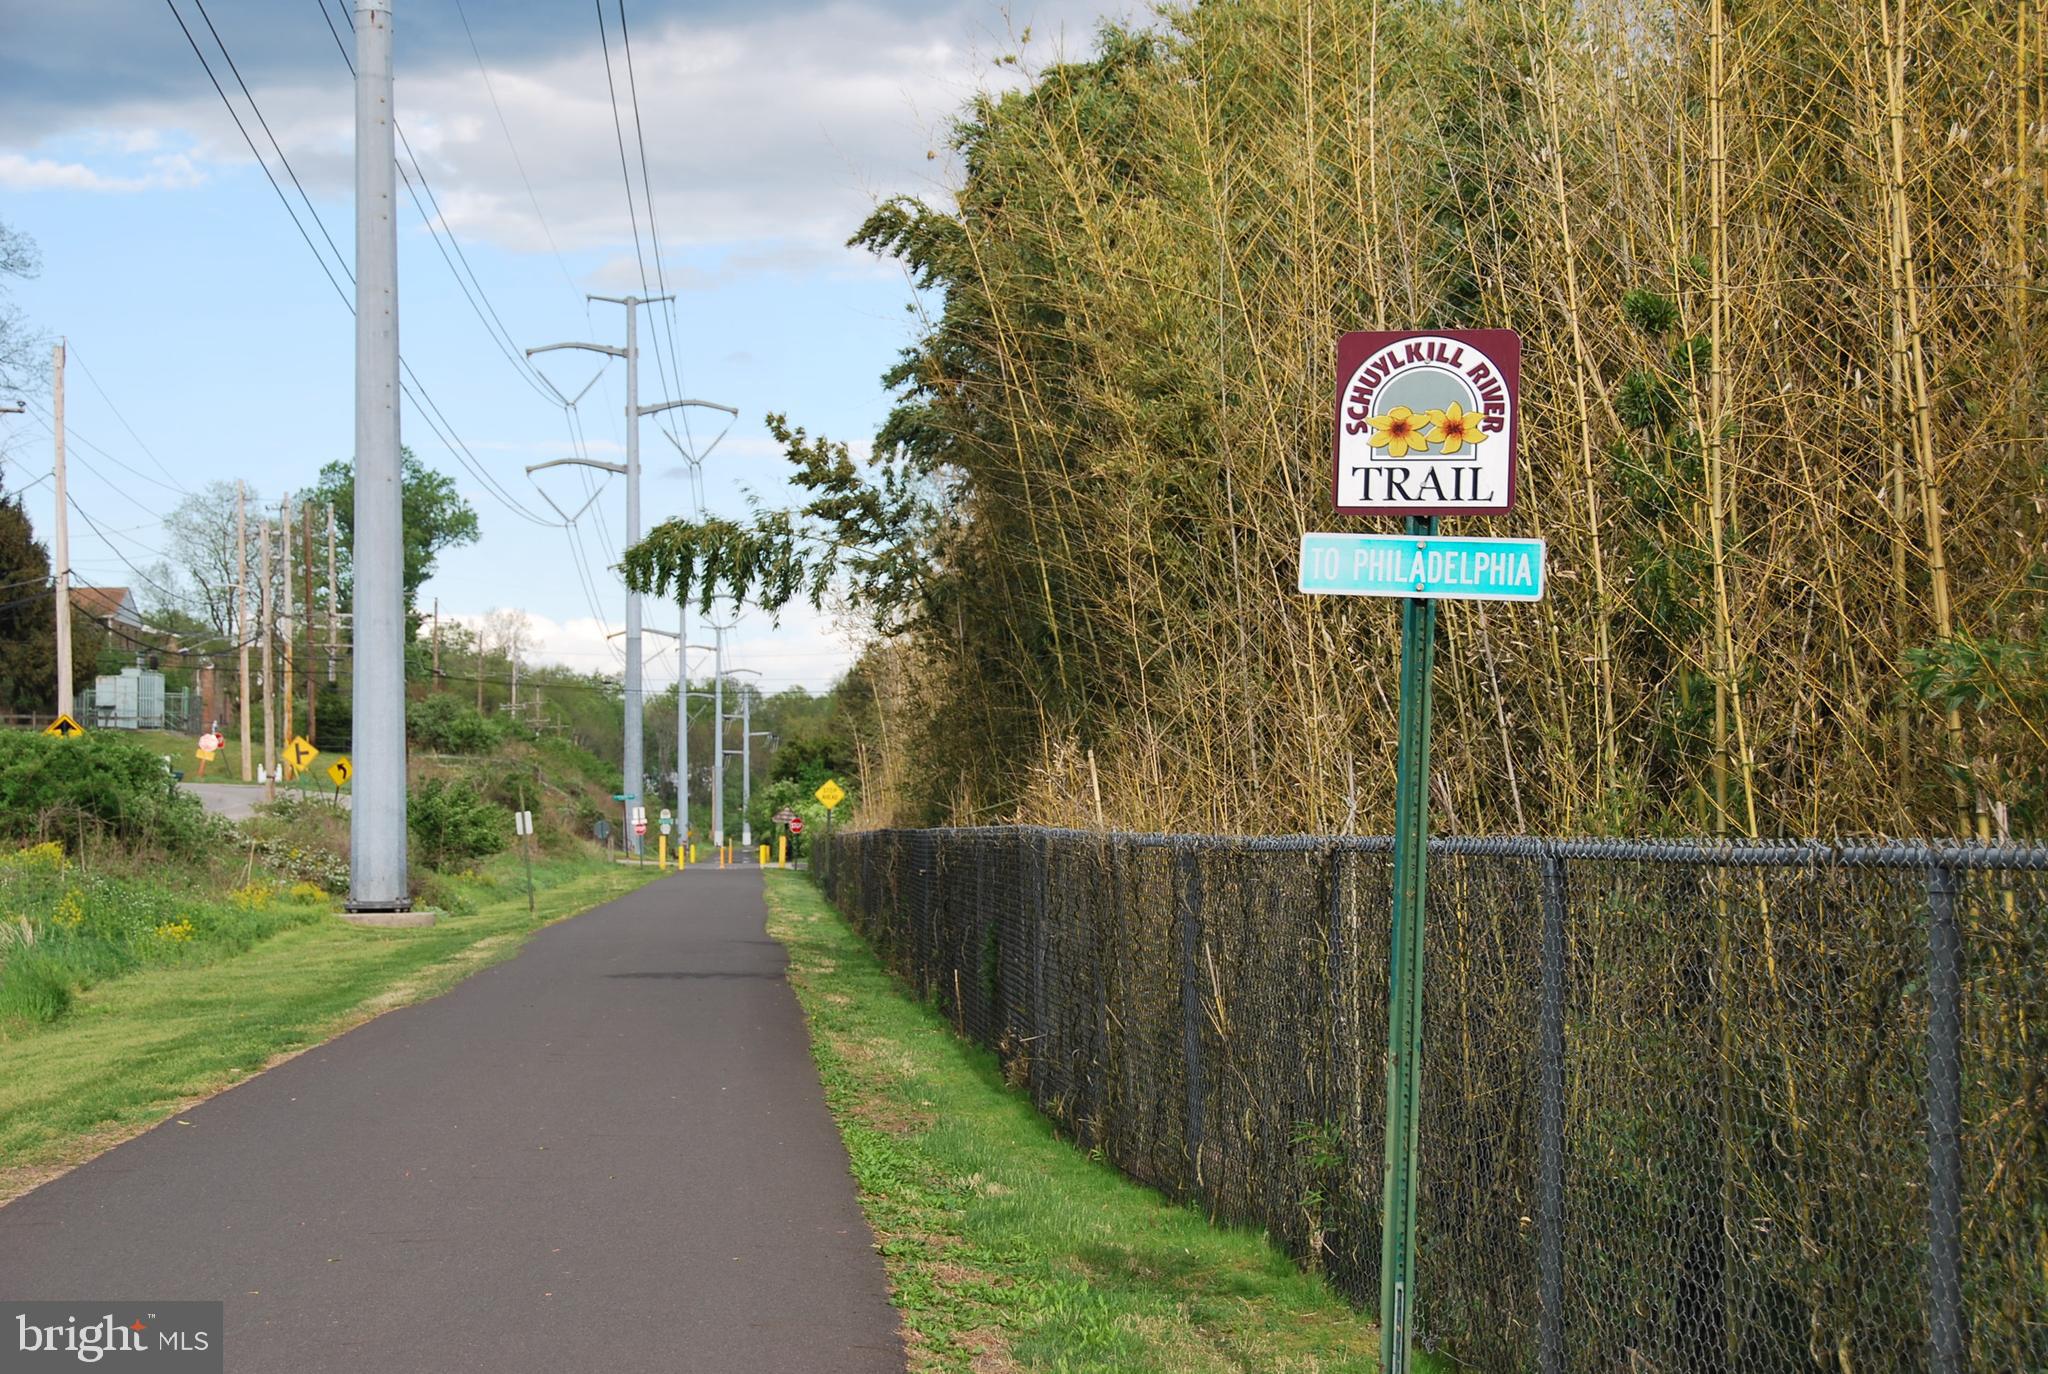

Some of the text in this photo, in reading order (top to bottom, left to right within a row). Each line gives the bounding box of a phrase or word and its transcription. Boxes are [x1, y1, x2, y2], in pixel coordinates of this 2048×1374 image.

[1346, 341, 1505, 436] SCHUYLKILL RIVER
[1352, 465, 1494, 502] TRAIL
[1312, 548, 1533, 587] TO PHILADELPHIA
